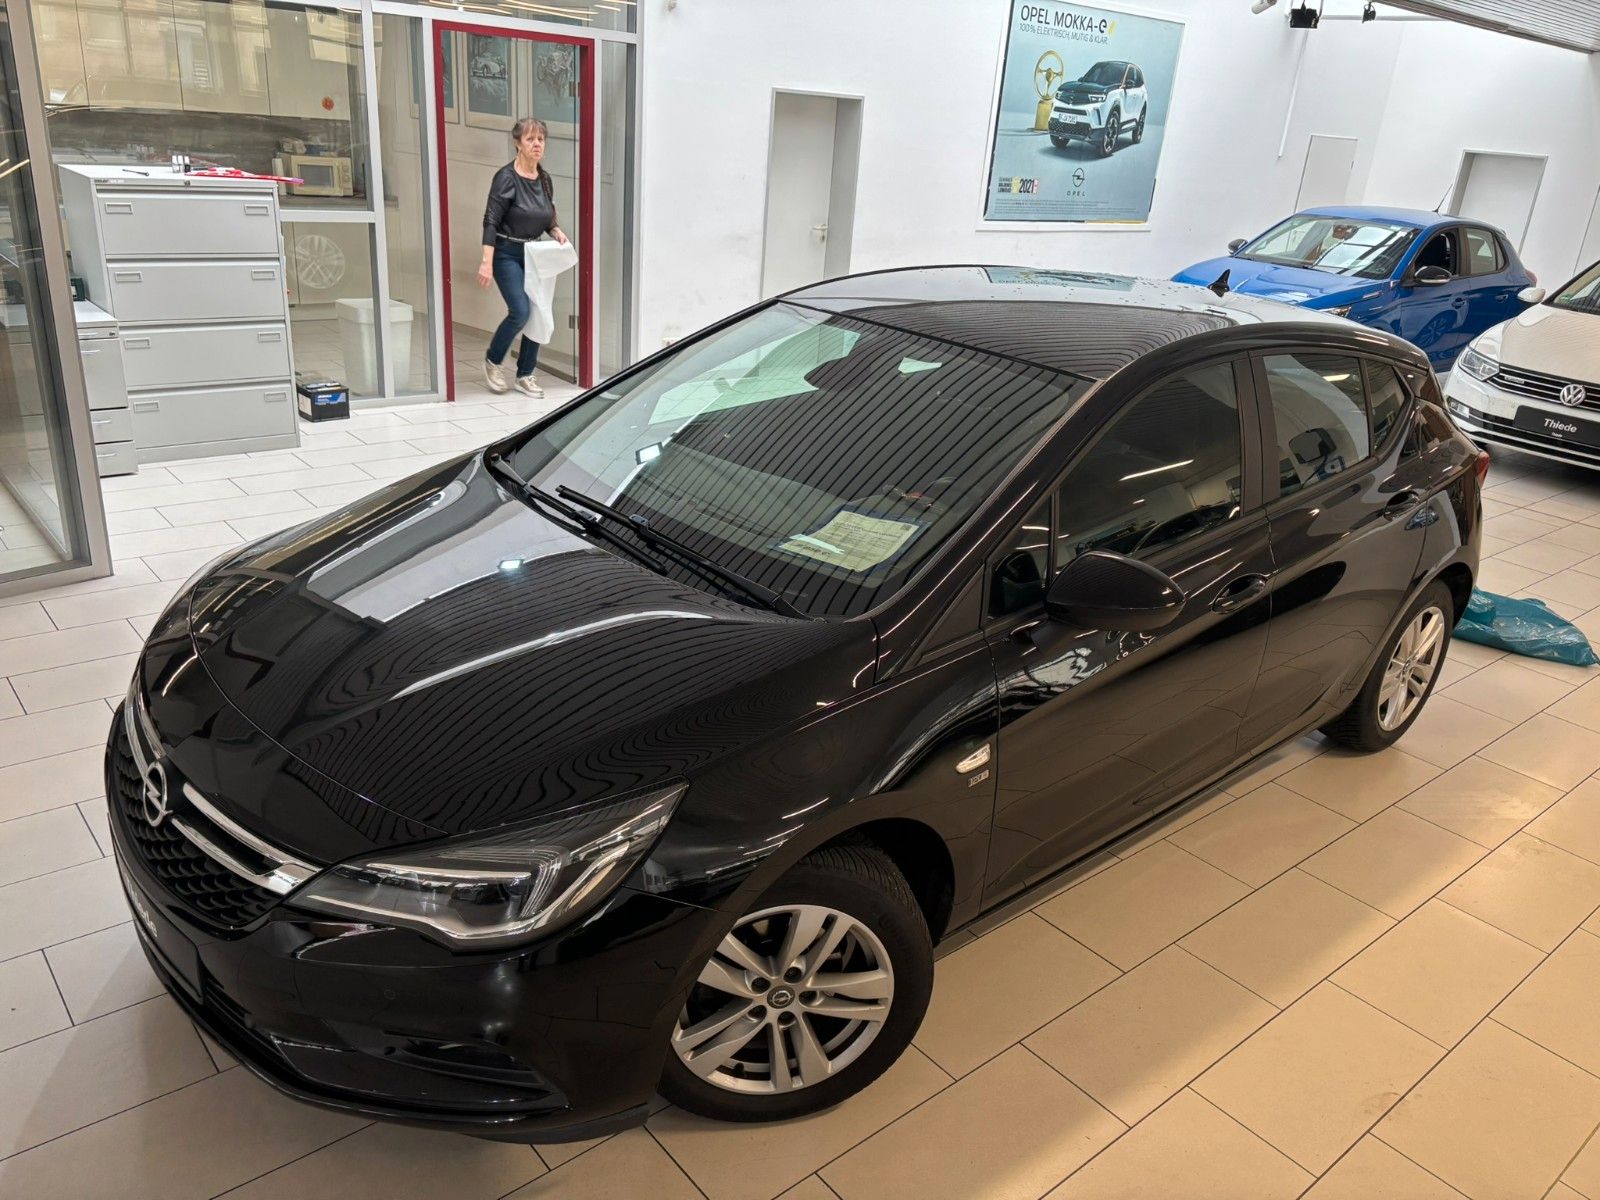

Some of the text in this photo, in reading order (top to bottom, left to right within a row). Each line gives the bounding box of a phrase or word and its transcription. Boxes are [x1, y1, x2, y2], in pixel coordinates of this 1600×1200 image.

[1020, 5, 1108, 34] OPEL MOKKA-e
[1019, 23, 1036, 34] 100%
[1018, 178, 1035, 195] 2021
[1543, 418, 1578, 433] Thiede
